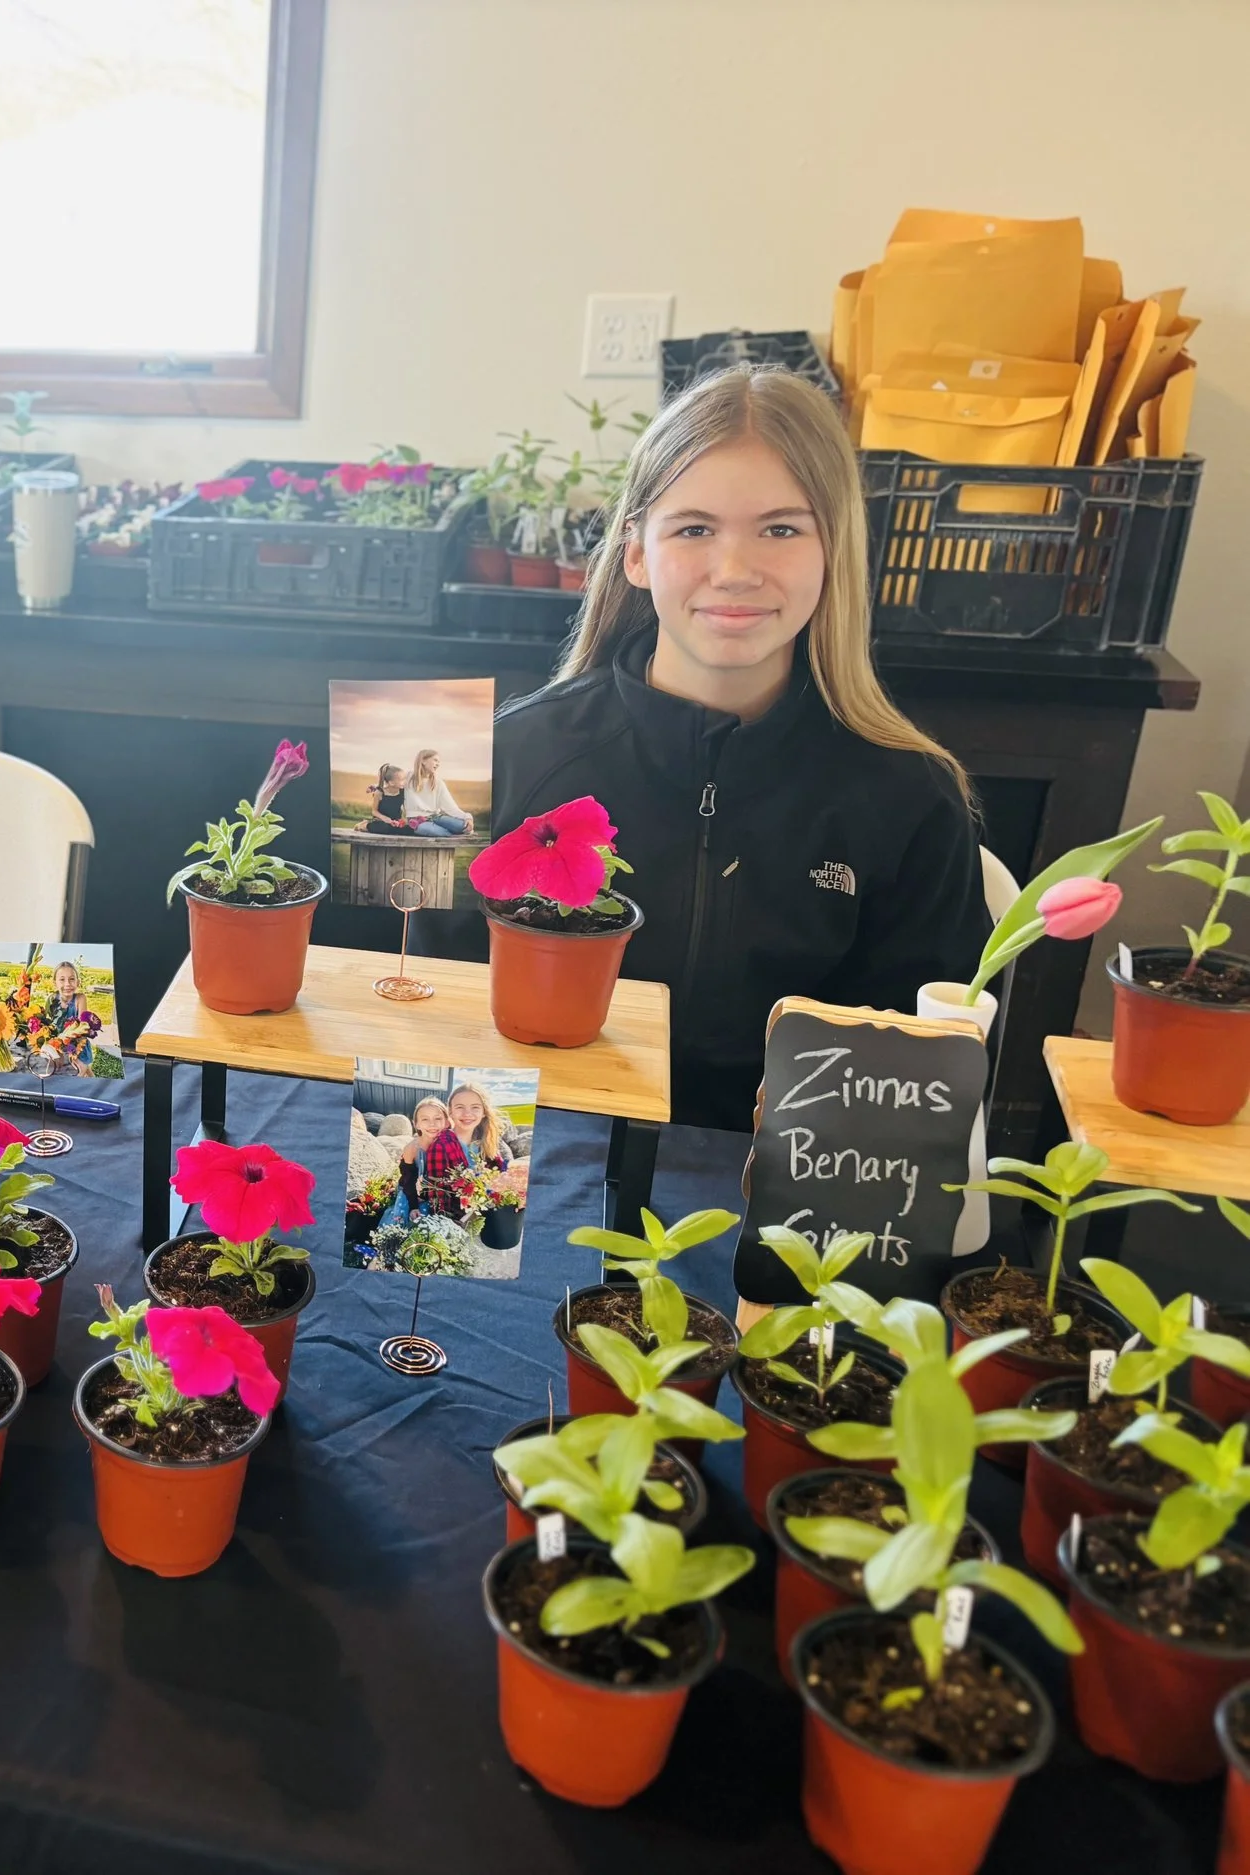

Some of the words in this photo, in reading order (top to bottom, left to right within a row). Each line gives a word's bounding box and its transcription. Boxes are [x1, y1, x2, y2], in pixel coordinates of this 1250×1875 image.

[823, 861, 845, 873] THE
[809, 869, 843, 881] NORTH
[815, 879, 841, 890] FACE
[773, 1047, 953, 1113] Zinnas
[778, 1126, 920, 1217] Benary
